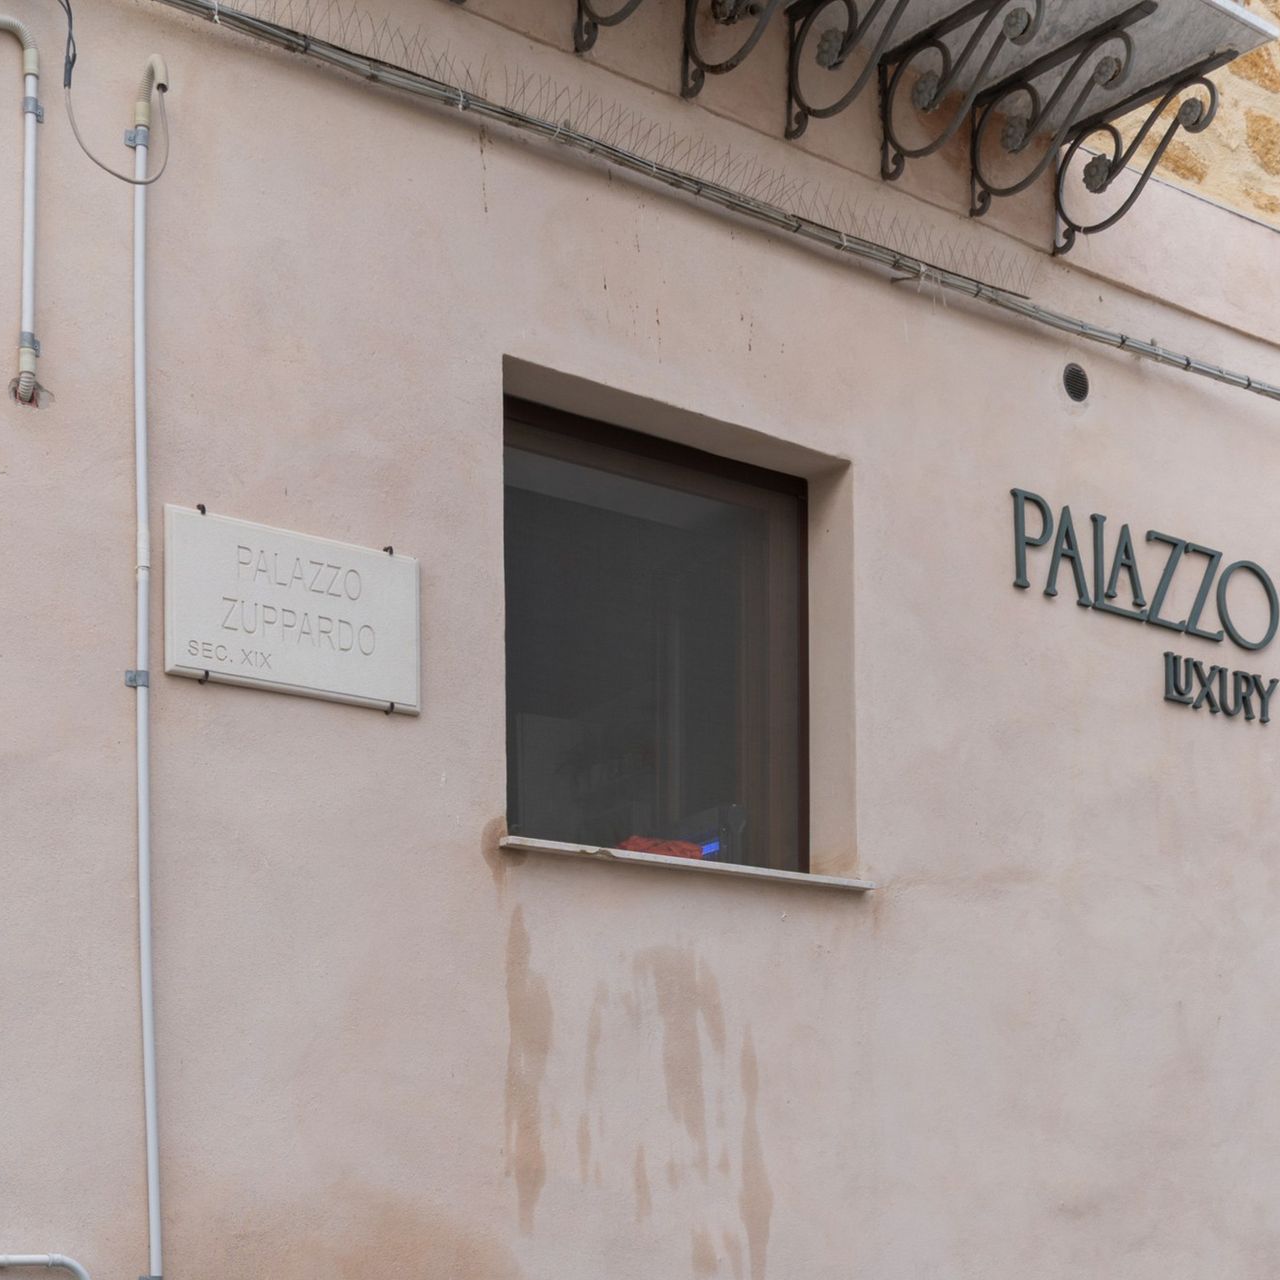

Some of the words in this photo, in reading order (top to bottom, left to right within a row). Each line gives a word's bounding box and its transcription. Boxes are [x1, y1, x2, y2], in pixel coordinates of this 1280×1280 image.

[236, 545, 362, 601] PALAZZO
[1009, 487, 1280, 651] PALAZZO
[187, 639, 233, 663] SEC.
[241, 649, 273, 669] XIX
[221, 596, 376, 657] ZUPPARDO
[1164, 651, 1279, 723] LUXURY
